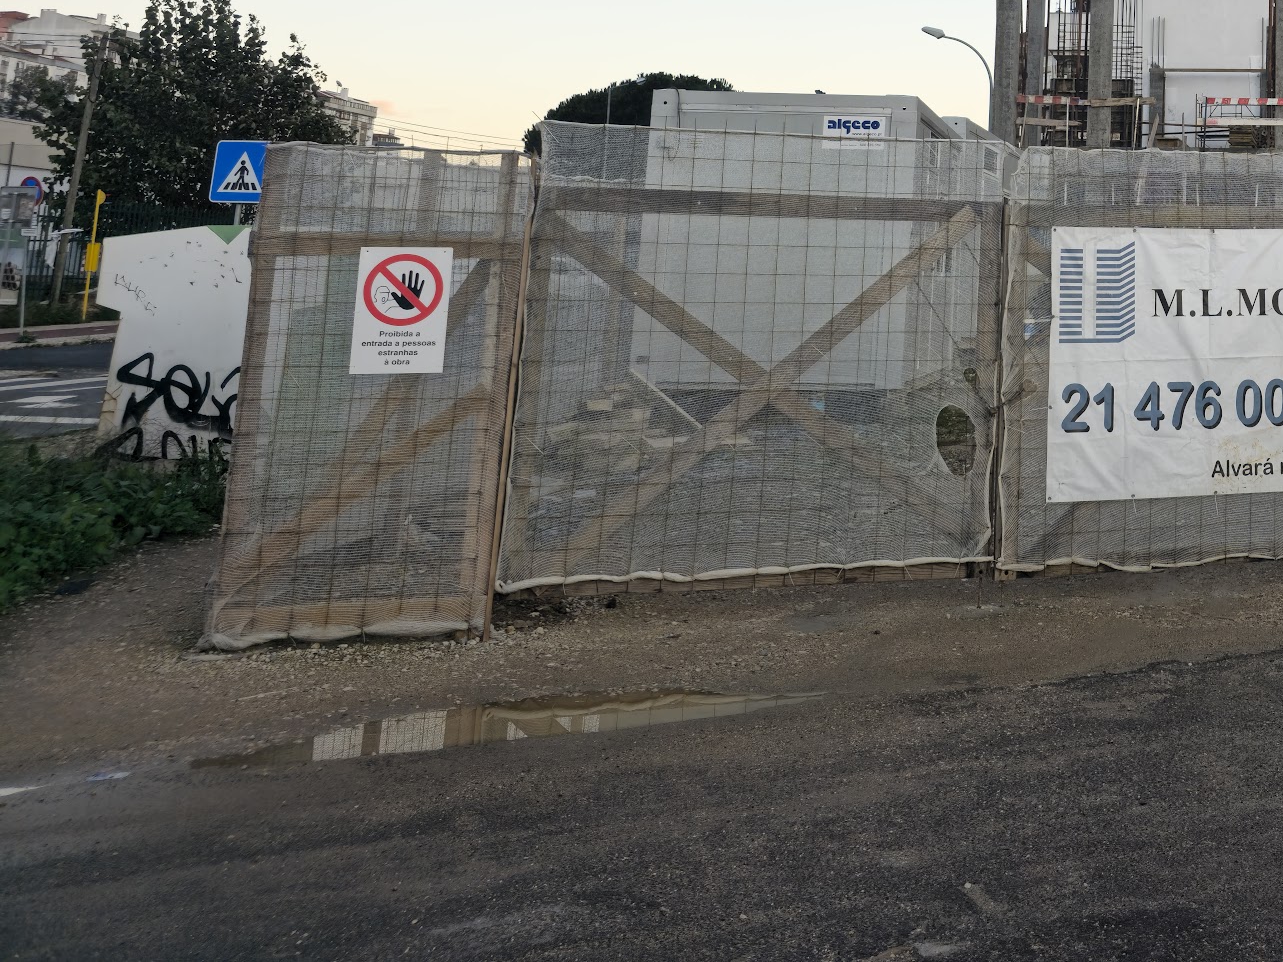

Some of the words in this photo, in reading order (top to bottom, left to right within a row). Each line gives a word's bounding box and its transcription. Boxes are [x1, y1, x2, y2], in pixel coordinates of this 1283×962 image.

[827, 118, 880, 134] algeco
[379, 330, 413, 338] Proibida
[402, 340, 436, 348] pessoas
[377, 349, 418, 357] estranhas
[391, 358, 410, 366] obra
[1060, 382, 1115, 433] 21
[1133, 379, 1223, 431] 476
[1211, 458, 1274, 478] Alvará
